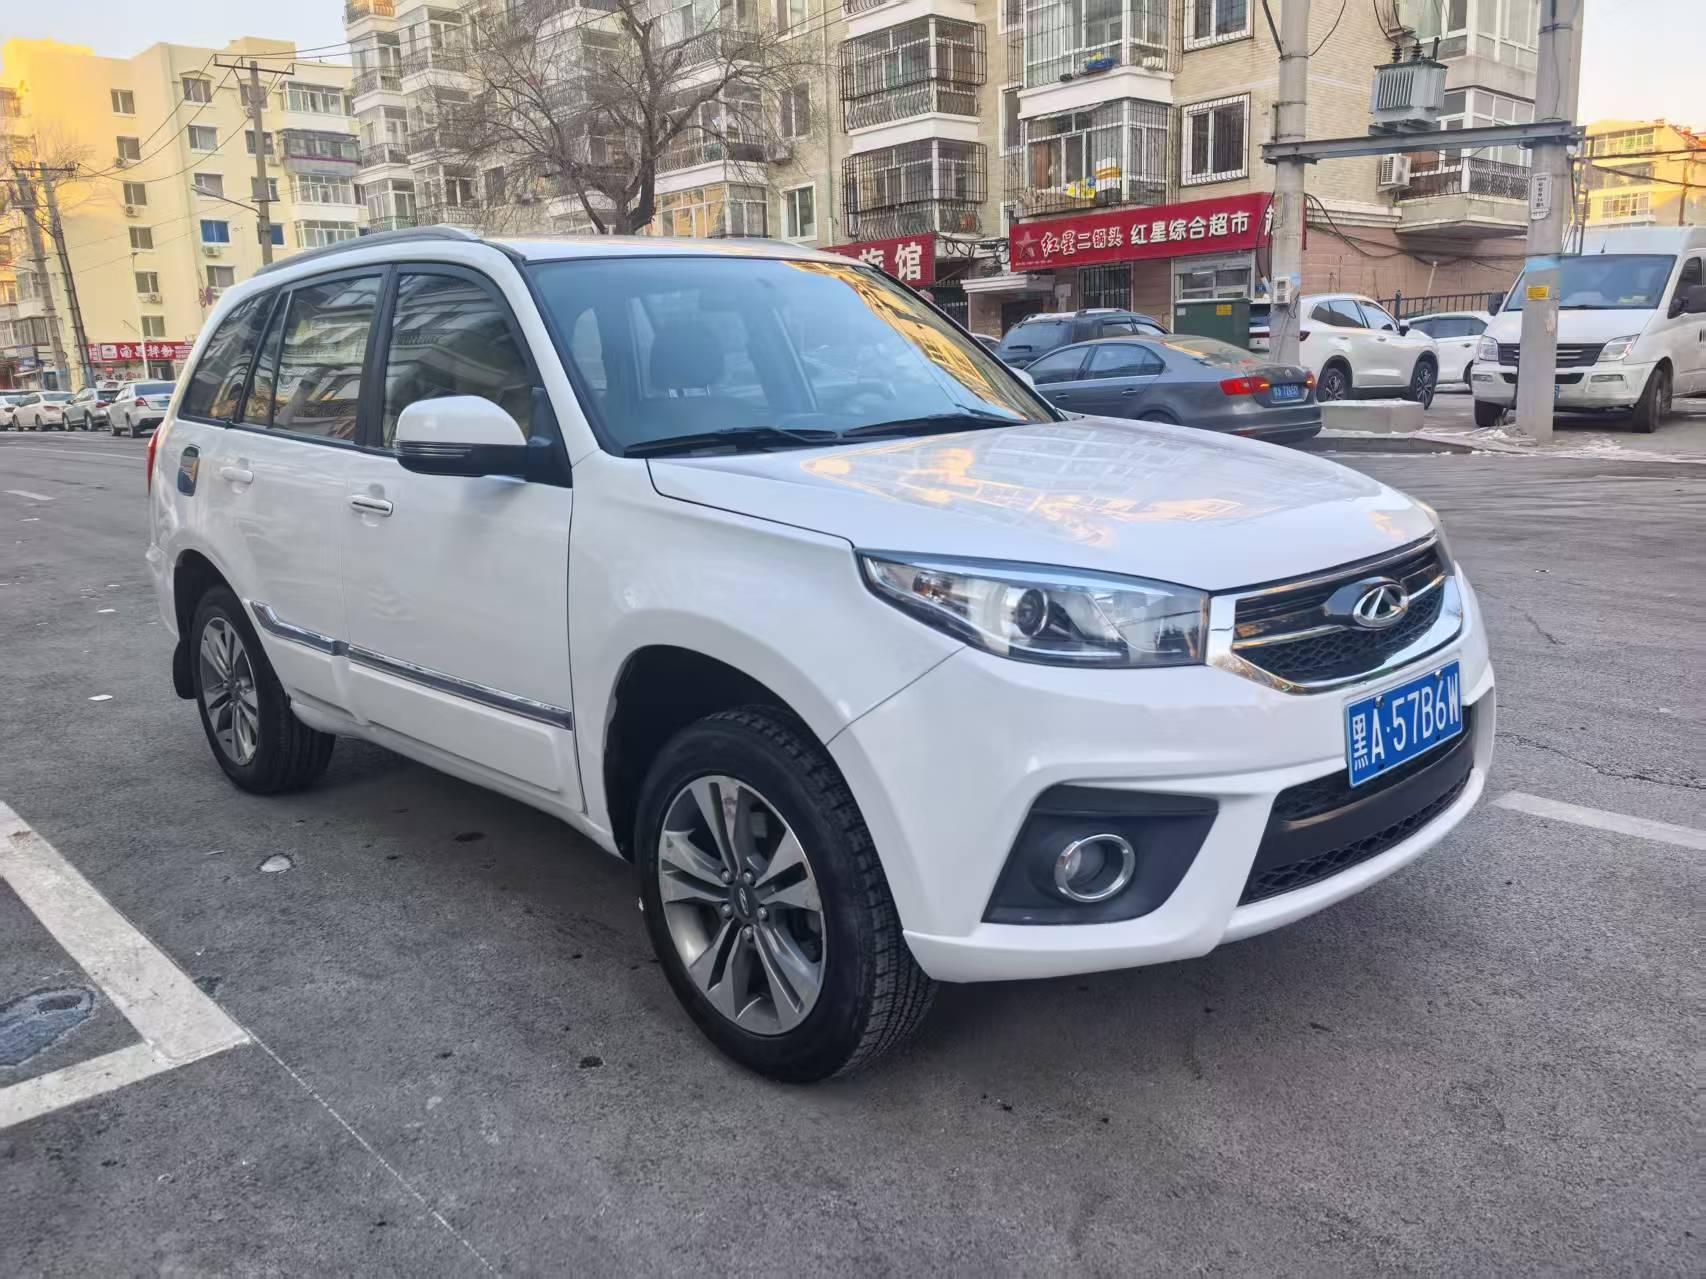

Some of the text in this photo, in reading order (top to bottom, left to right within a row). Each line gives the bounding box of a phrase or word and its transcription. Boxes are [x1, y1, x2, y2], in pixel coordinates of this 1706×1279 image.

[1040, 227, 1122, 257] 红星二锅头
[1130, 211, 1250, 245] 红星综合超市
